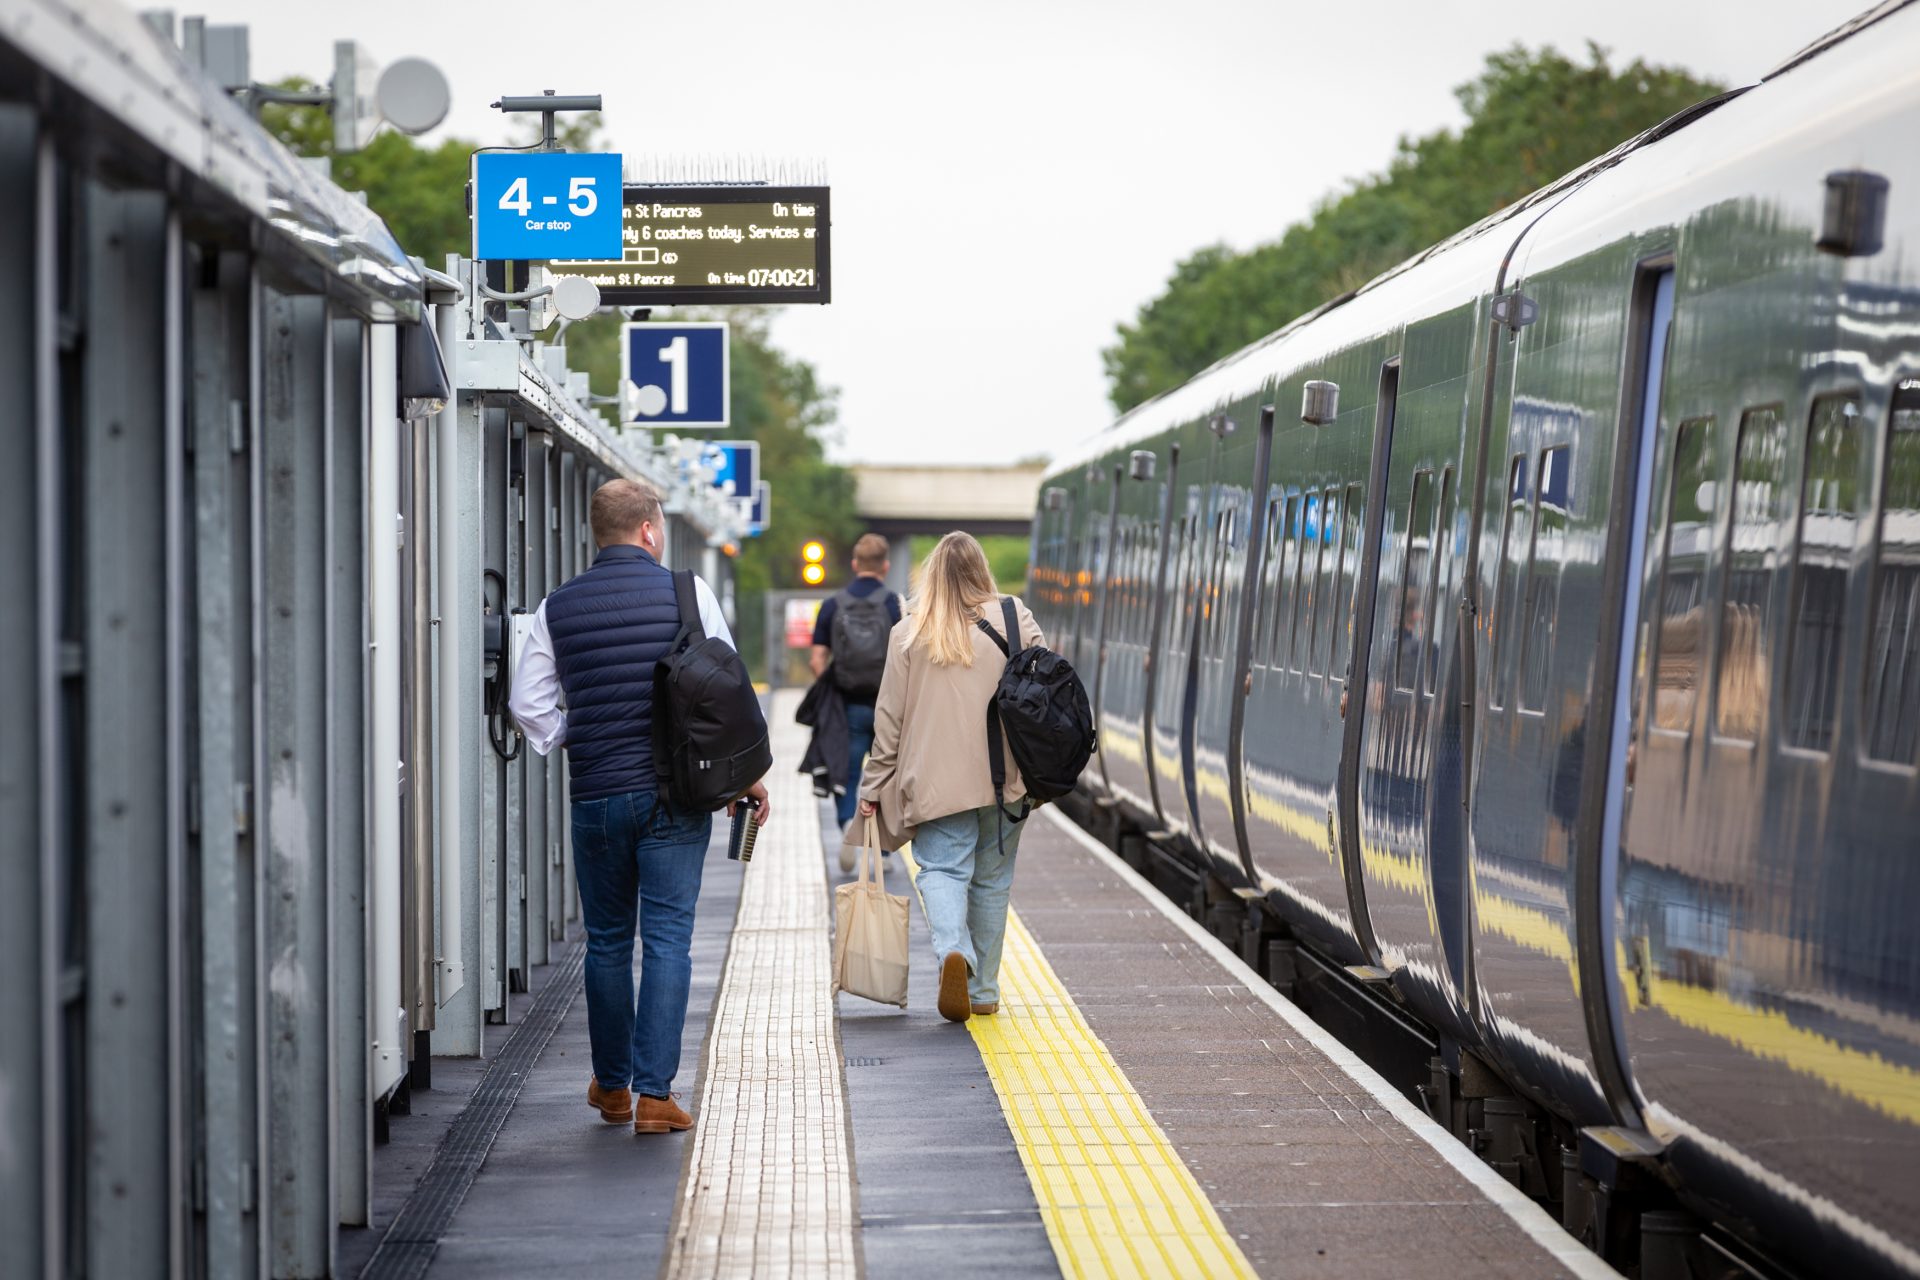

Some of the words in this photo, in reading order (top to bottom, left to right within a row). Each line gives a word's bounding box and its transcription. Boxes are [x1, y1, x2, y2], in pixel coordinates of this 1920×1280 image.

[498, 177, 532, 216] 4
[568, 177, 598, 217] 5
[635, 203, 649, 218] St
[653, 203, 702, 218] Pancras
[772, 202, 788, 217] On
[792, 203, 816, 217] time
[525, 220, 545, 230] Car
[546, 220, 571, 231] stop
[622, 225, 639, 244] nly
[642, 225, 651, 240] 6
[655, 225, 703, 240] coaches
[707, 225, 745, 243] today.
[748, 225, 800, 239] Services
[803, 227, 816, 239] ar
[618, 273, 631, 285] St
[633, 273, 675, 285] Pancras
[707, 272, 720, 284] On
[724, 272, 745, 285] time
[748, 268, 814, 286] 07:00:21
[658, 336, 688, 414] 1
